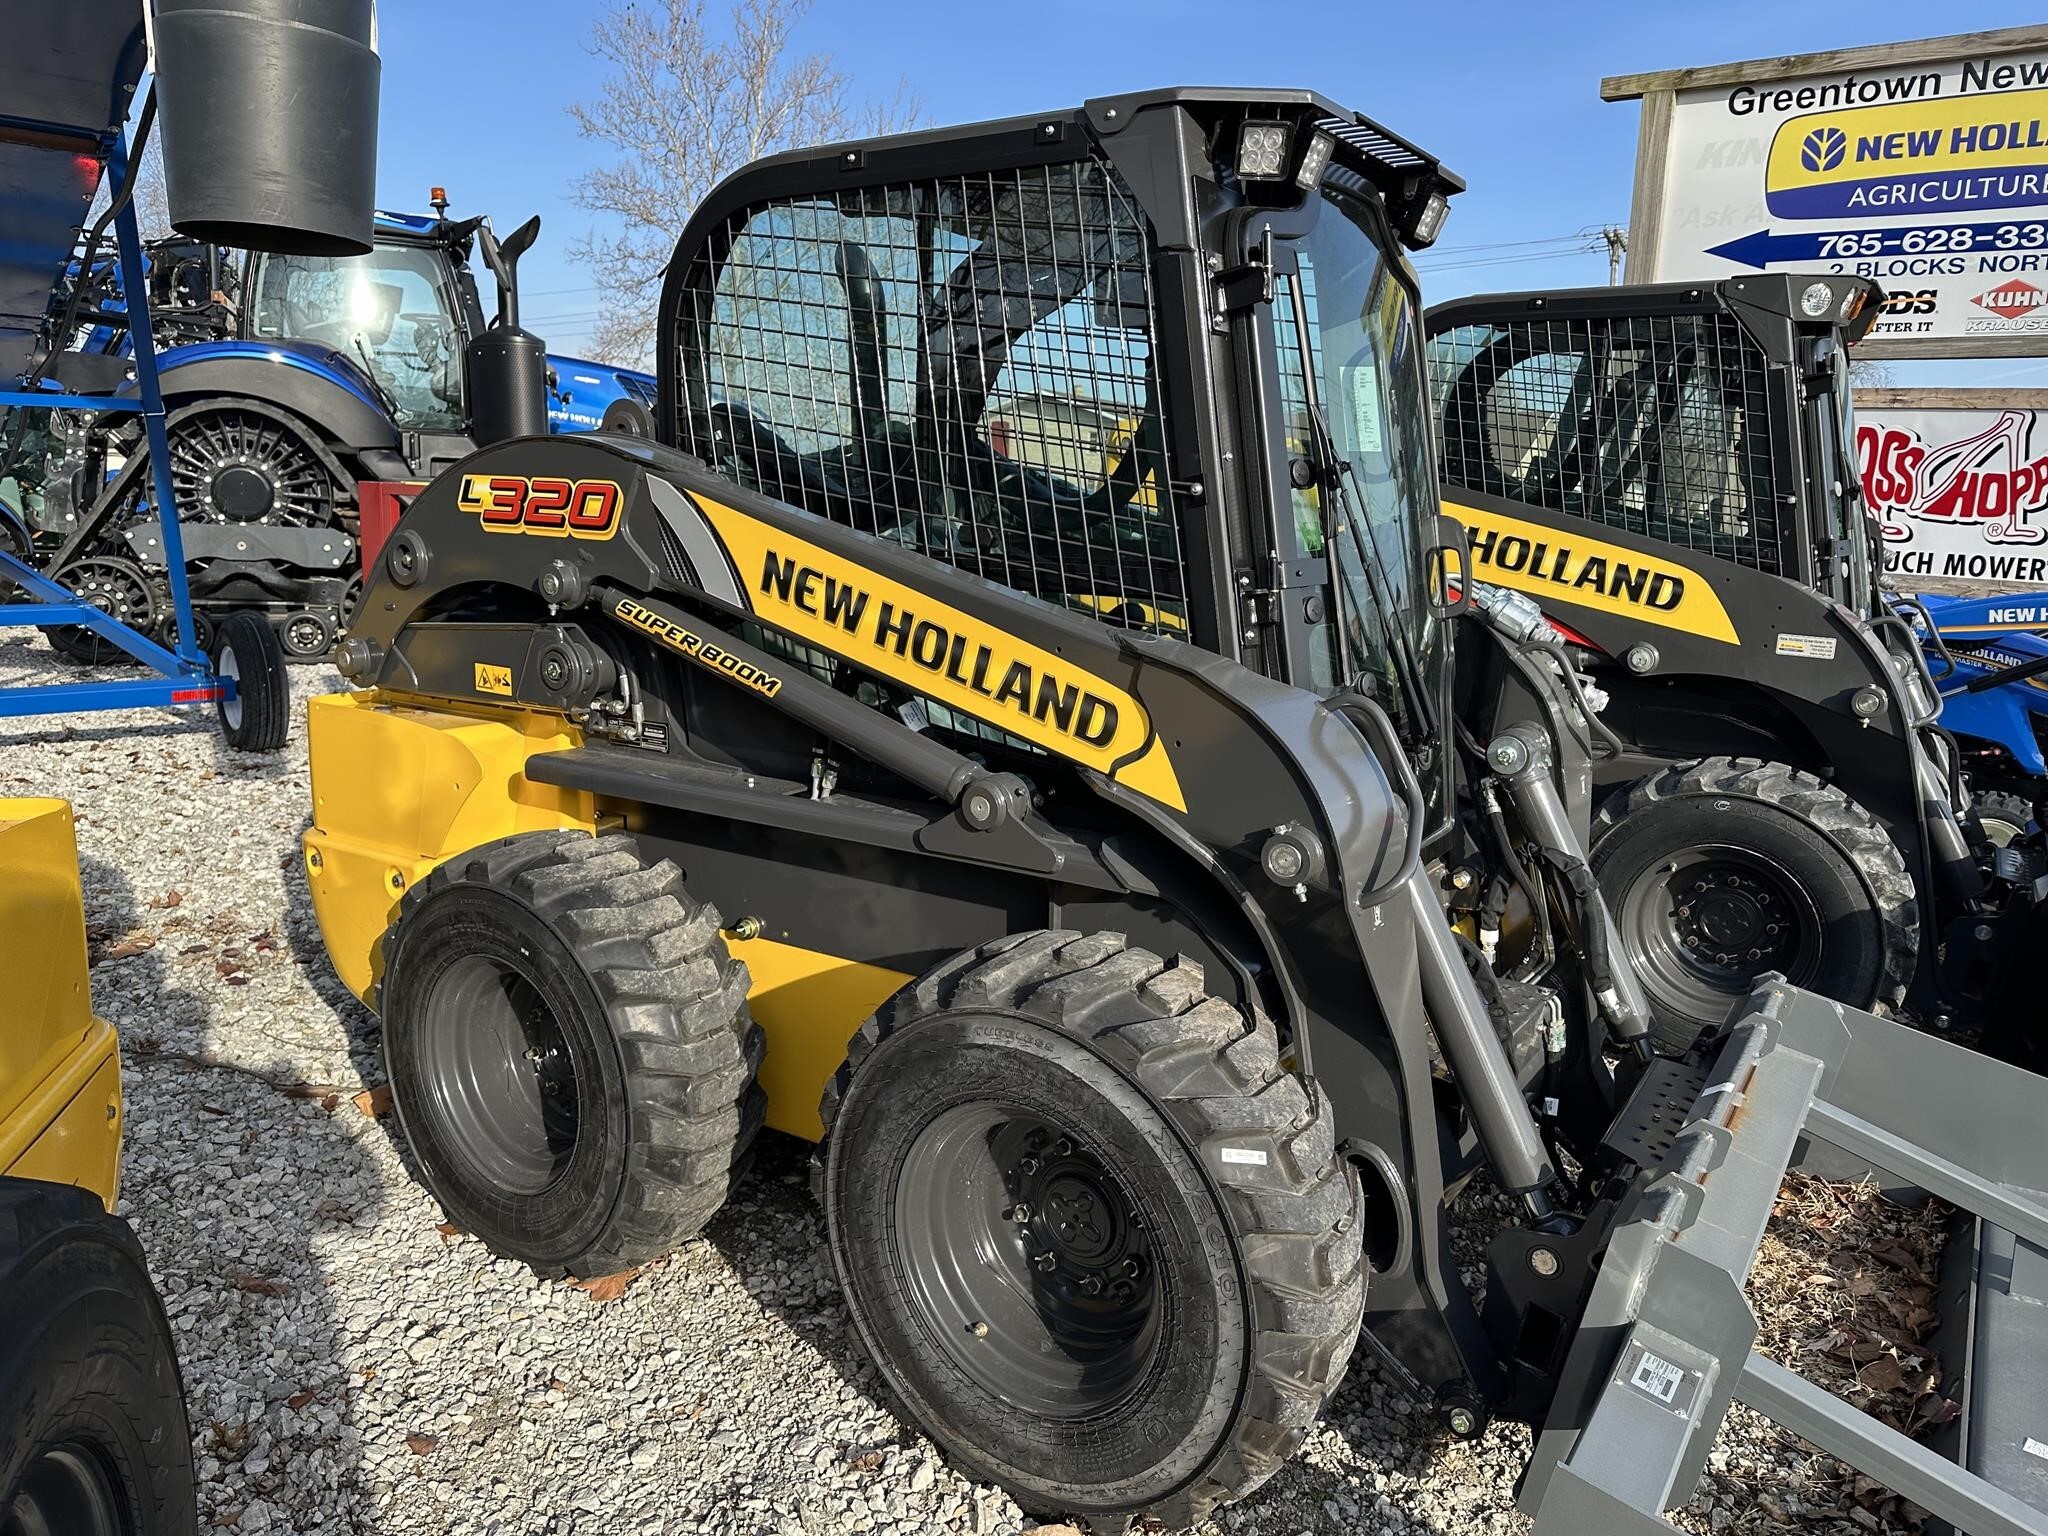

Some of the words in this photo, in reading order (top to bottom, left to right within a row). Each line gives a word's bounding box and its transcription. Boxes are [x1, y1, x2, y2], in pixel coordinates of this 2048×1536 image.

[1727, 72, 1942, 116] Greentown
[1959, 59, 2048, 93] New
[1855, 129, 1944, 162] NEW
[1950, 120, 2048, 154] HOLL
[1817, 223, 2048, 258] 765-628-33
[1856, 256, 1966, 277] BLOCKS
[1878, 289, 1938, 315] DS
[1980, 289, 2048, 308] KUHN
[1917, 321, 1934, 332] IT
[459, 475, 623, 540] L320
[1465, 525, 1685, 612] HOLLAND
[1988, 607, 2036, 623] NEW
[615, 599, 702, 655] SUPER
[699, 643, 782, 698] BOOM
[760, 548, 870, 635] NEW
[873, 600, 1120, 749] HOLLAND
